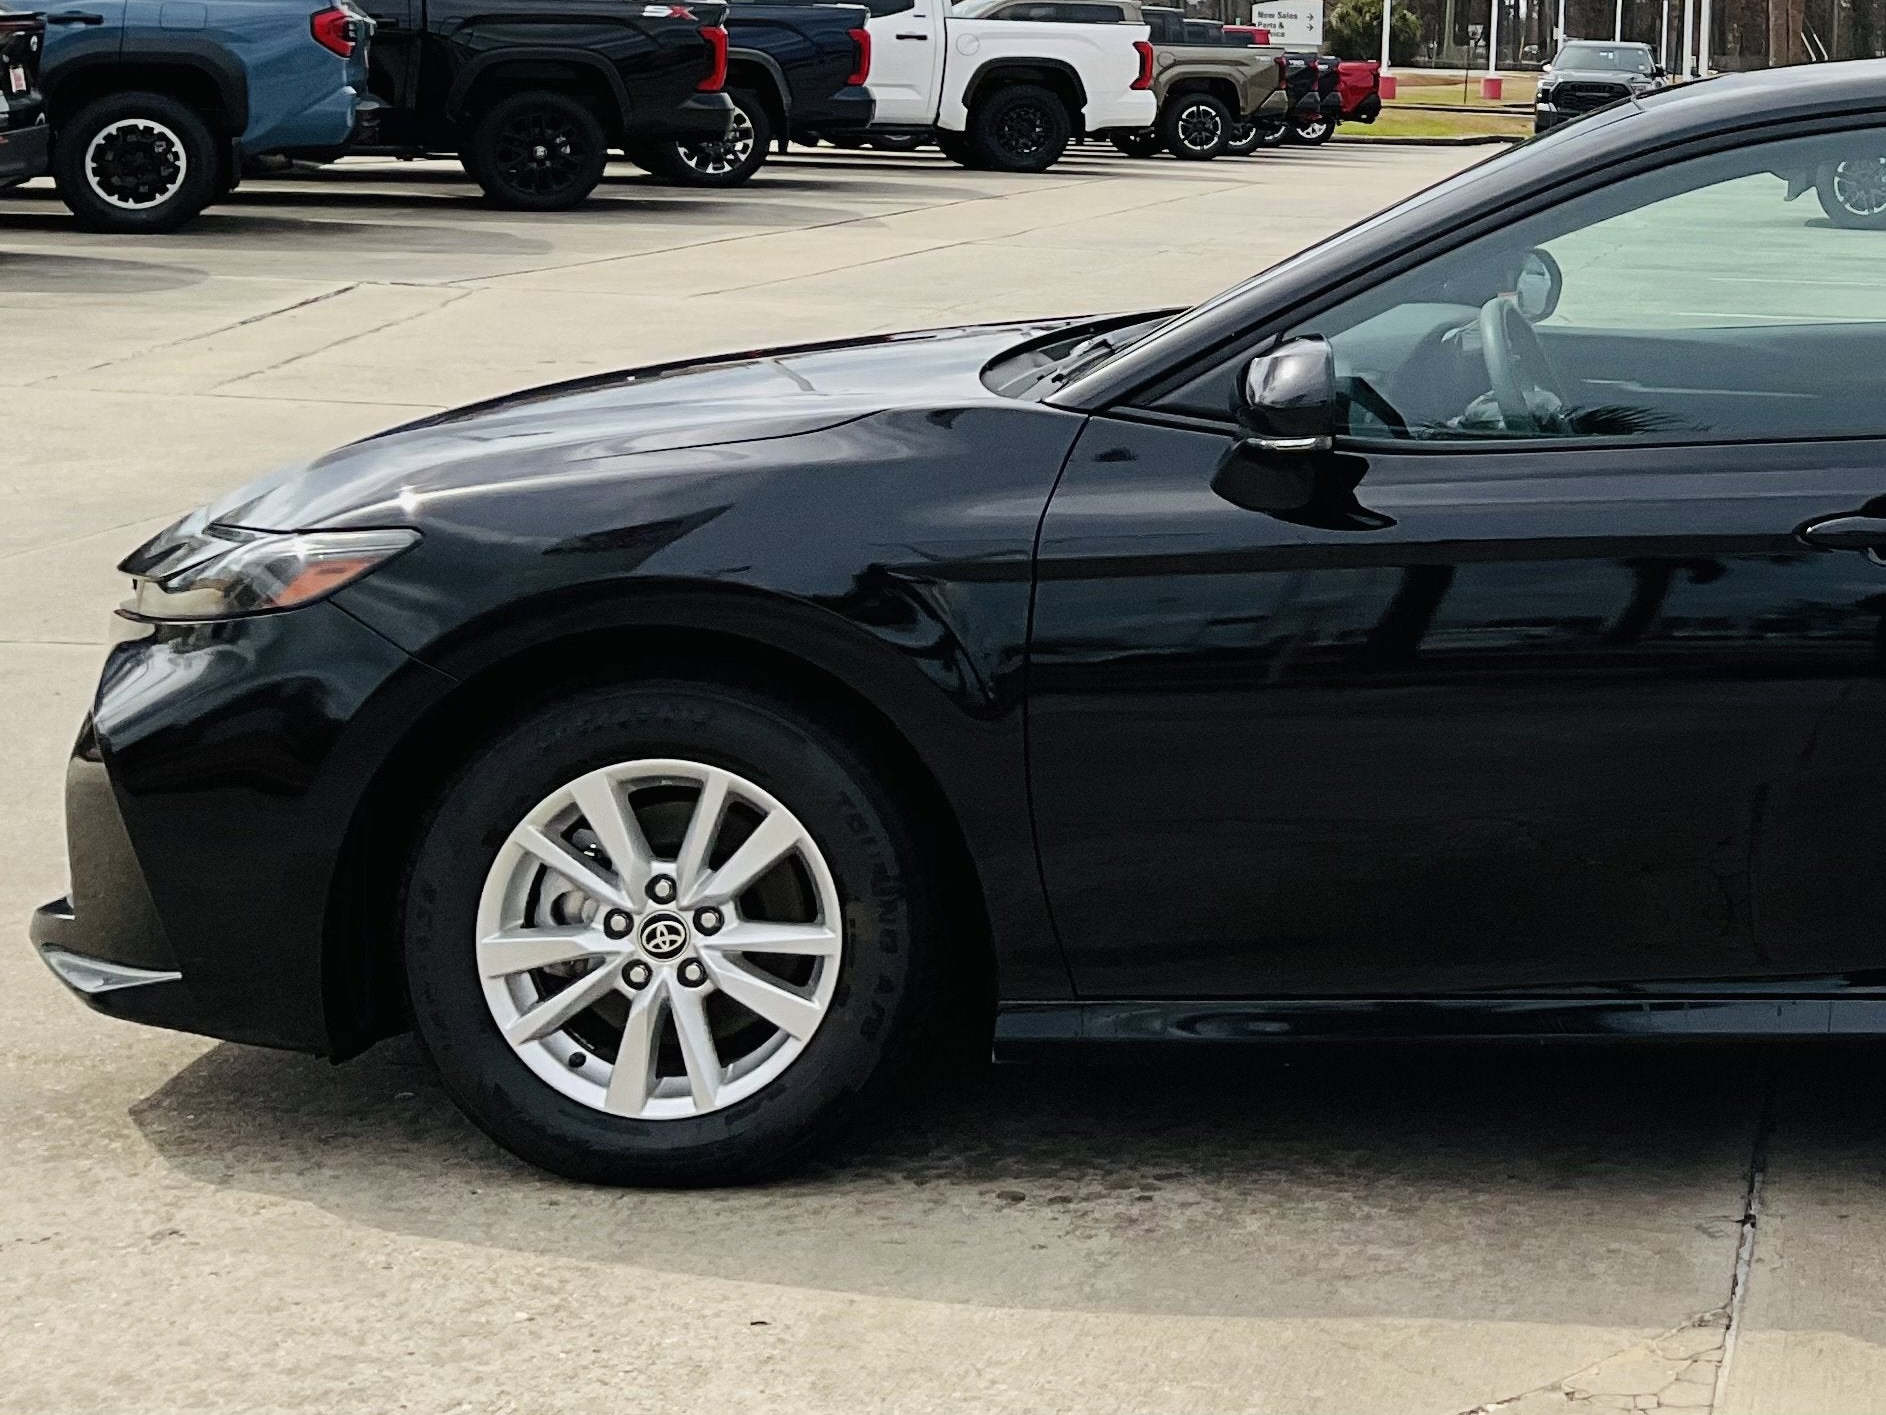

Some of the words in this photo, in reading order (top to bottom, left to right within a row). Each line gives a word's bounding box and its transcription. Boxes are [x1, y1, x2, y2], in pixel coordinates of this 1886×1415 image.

[1257, 11, 1275, 19] New
[1277, 11, 1298, 20] Sales
[1257, 21, 1276, 29] Parts
[1278, 22, 1285, 30] &
